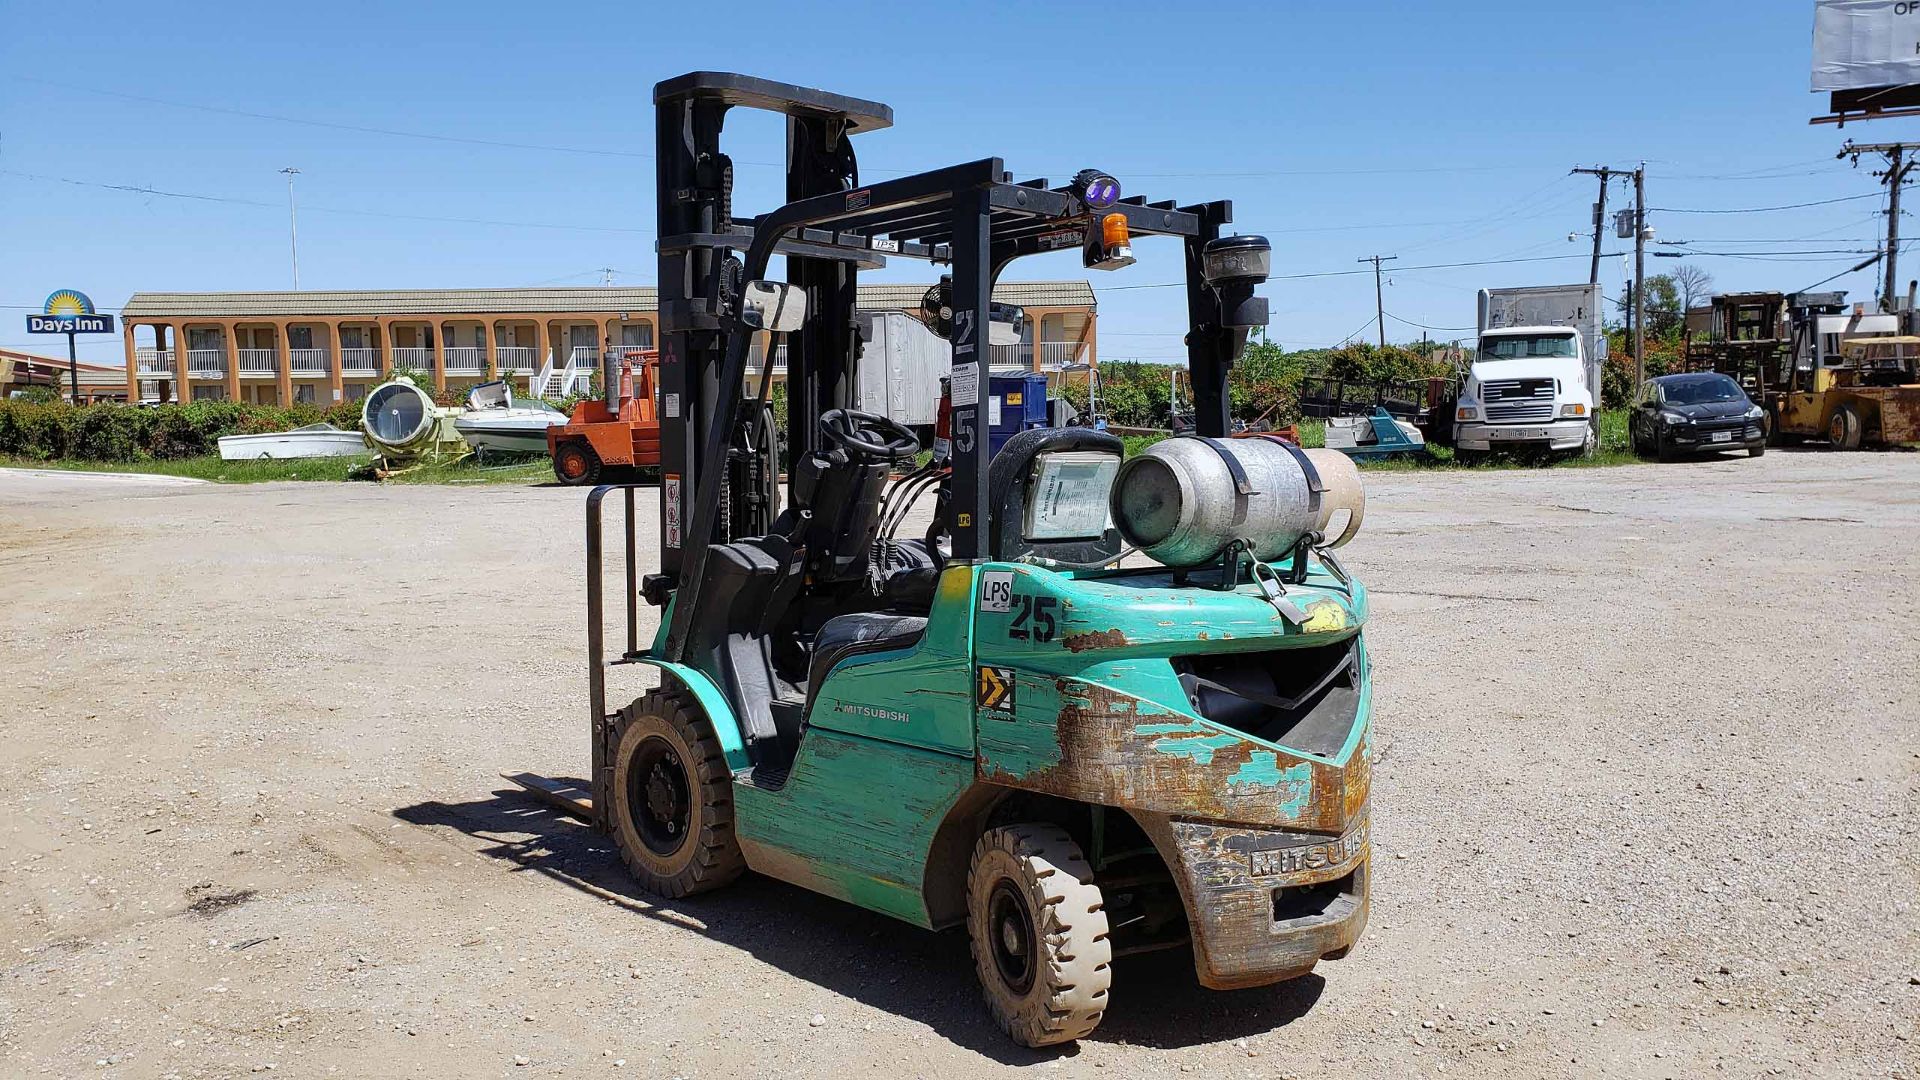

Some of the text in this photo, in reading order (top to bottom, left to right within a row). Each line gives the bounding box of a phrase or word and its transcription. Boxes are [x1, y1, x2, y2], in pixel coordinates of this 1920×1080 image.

[31, 318, 104, 332] Days Inn
[955, 309, 975, 355] 2
[956, 409, 975, 453] 5
[983, 581, 1010, 602] LPS
[1008, 594, 1057, 643] 25
[844, 704, 910, 723] MITSUBISHI
